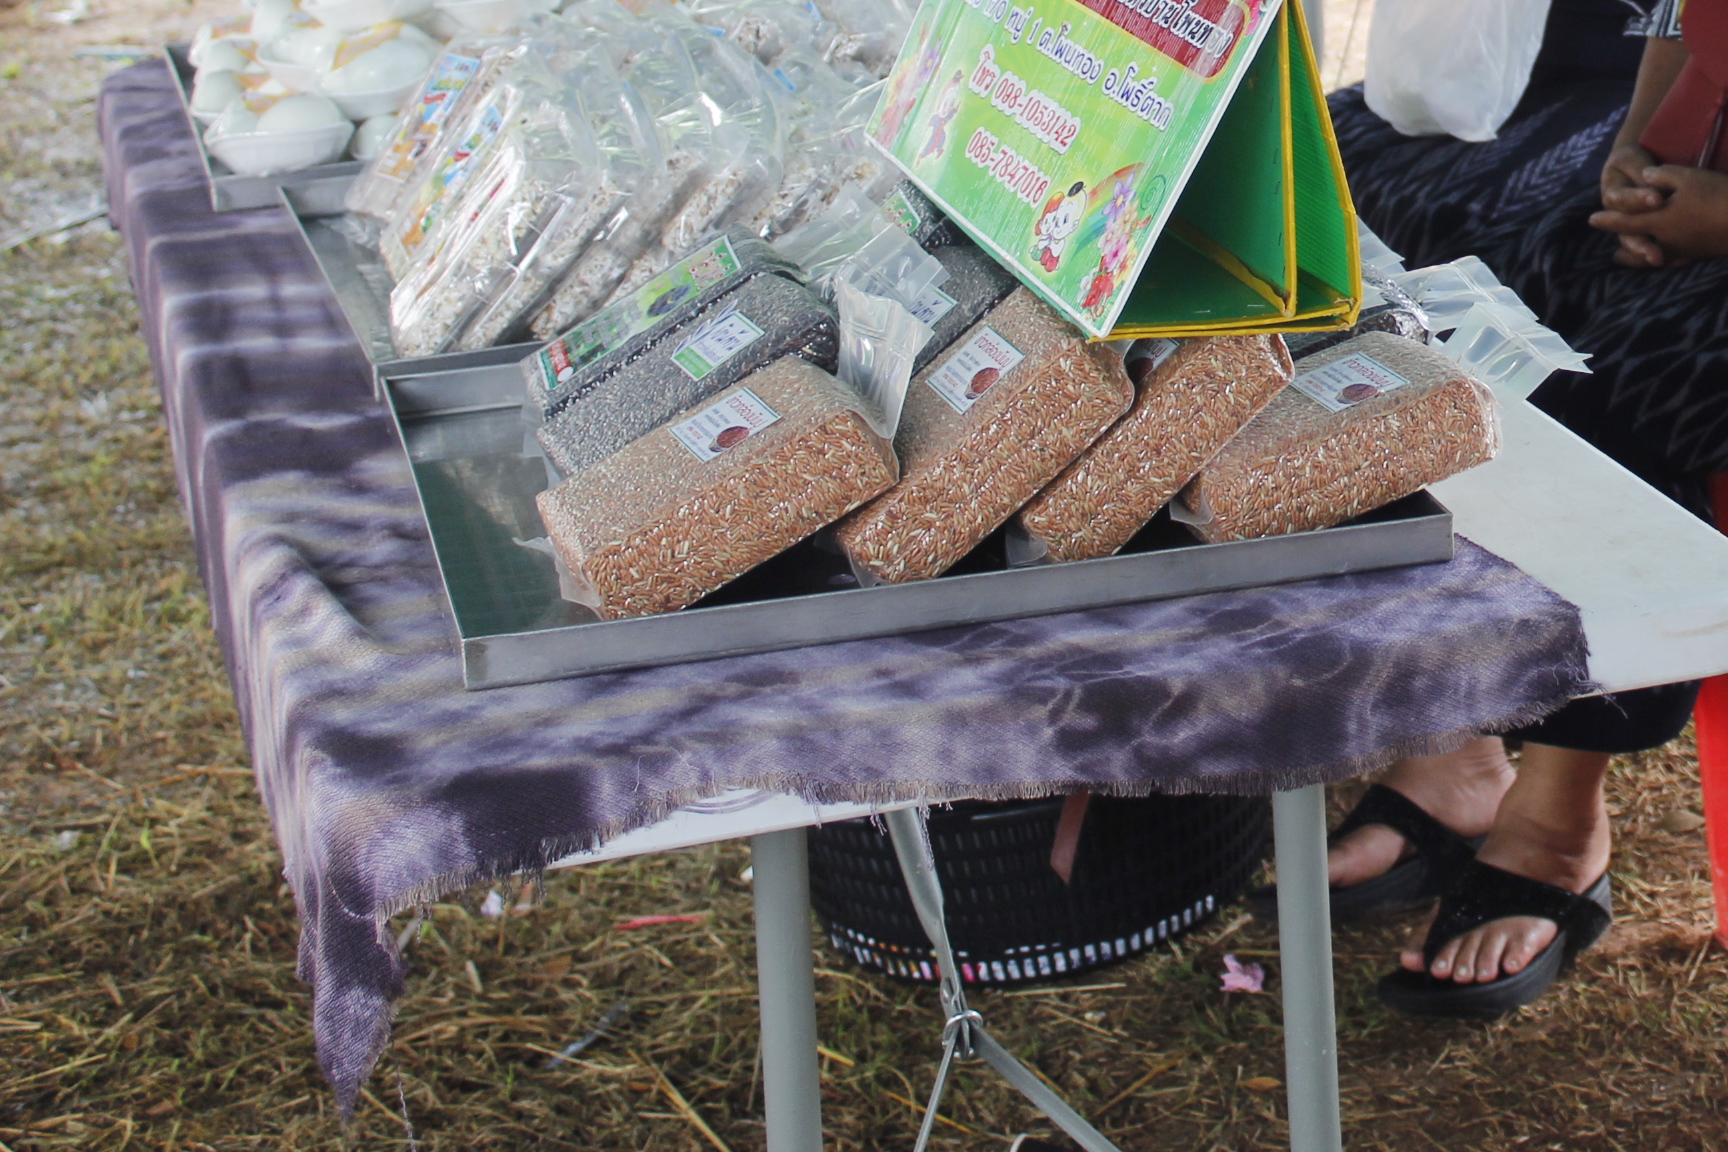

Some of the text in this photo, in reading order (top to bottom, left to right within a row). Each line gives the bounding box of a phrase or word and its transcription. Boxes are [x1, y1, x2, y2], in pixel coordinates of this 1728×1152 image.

[972, 50, 1078, 148] โทร 098-1053142
[1005, 5, 1033, 43] หมู่
[1026, 16, 1042, 43] 1
[1036, 22, 1104, 82] ต.โพนทอง
[1101, 63, 1176, 130] อ.โพธิ์ตาก
[968, 129, 1049, 206] 085-7847016
